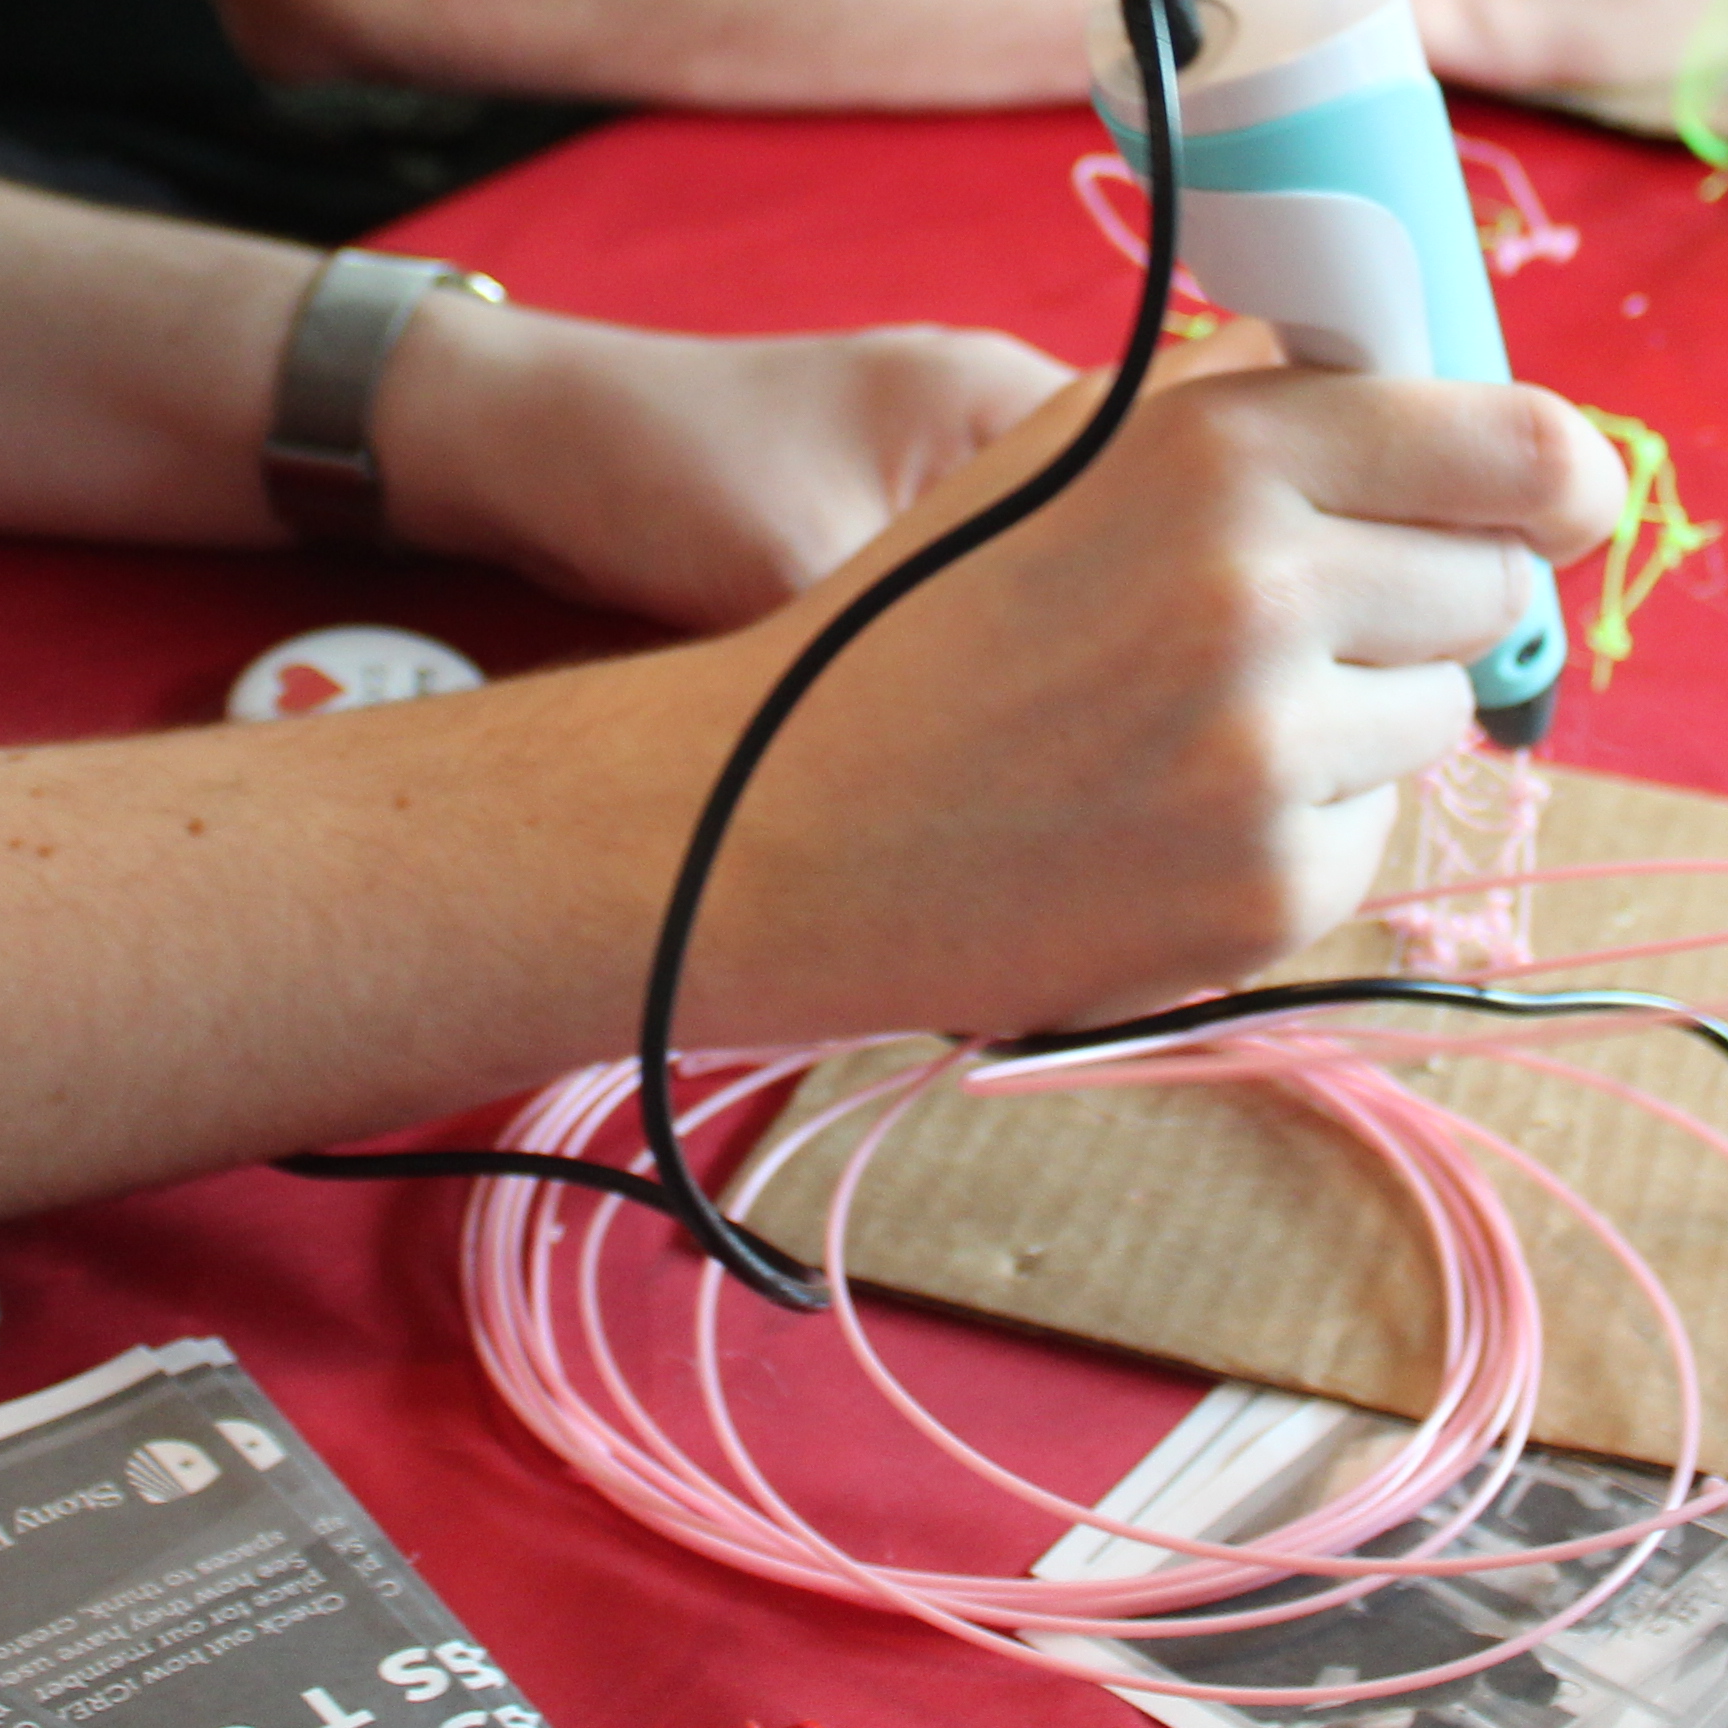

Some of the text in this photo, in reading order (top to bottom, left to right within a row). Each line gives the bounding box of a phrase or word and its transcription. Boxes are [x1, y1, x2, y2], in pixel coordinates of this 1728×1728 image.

[15, 1482, 123, 1533] Stony
[163, 1569, 198, 1586] to
[192, 1569, 248, 1605] how
[129, 1597, 195, 1632] they
[257, 1593, 344, 1633] Check
[53, 1624, 130, 1665] have
[203, 1628, 254, 1663] out
[143, 1649, 207, 1683] how
